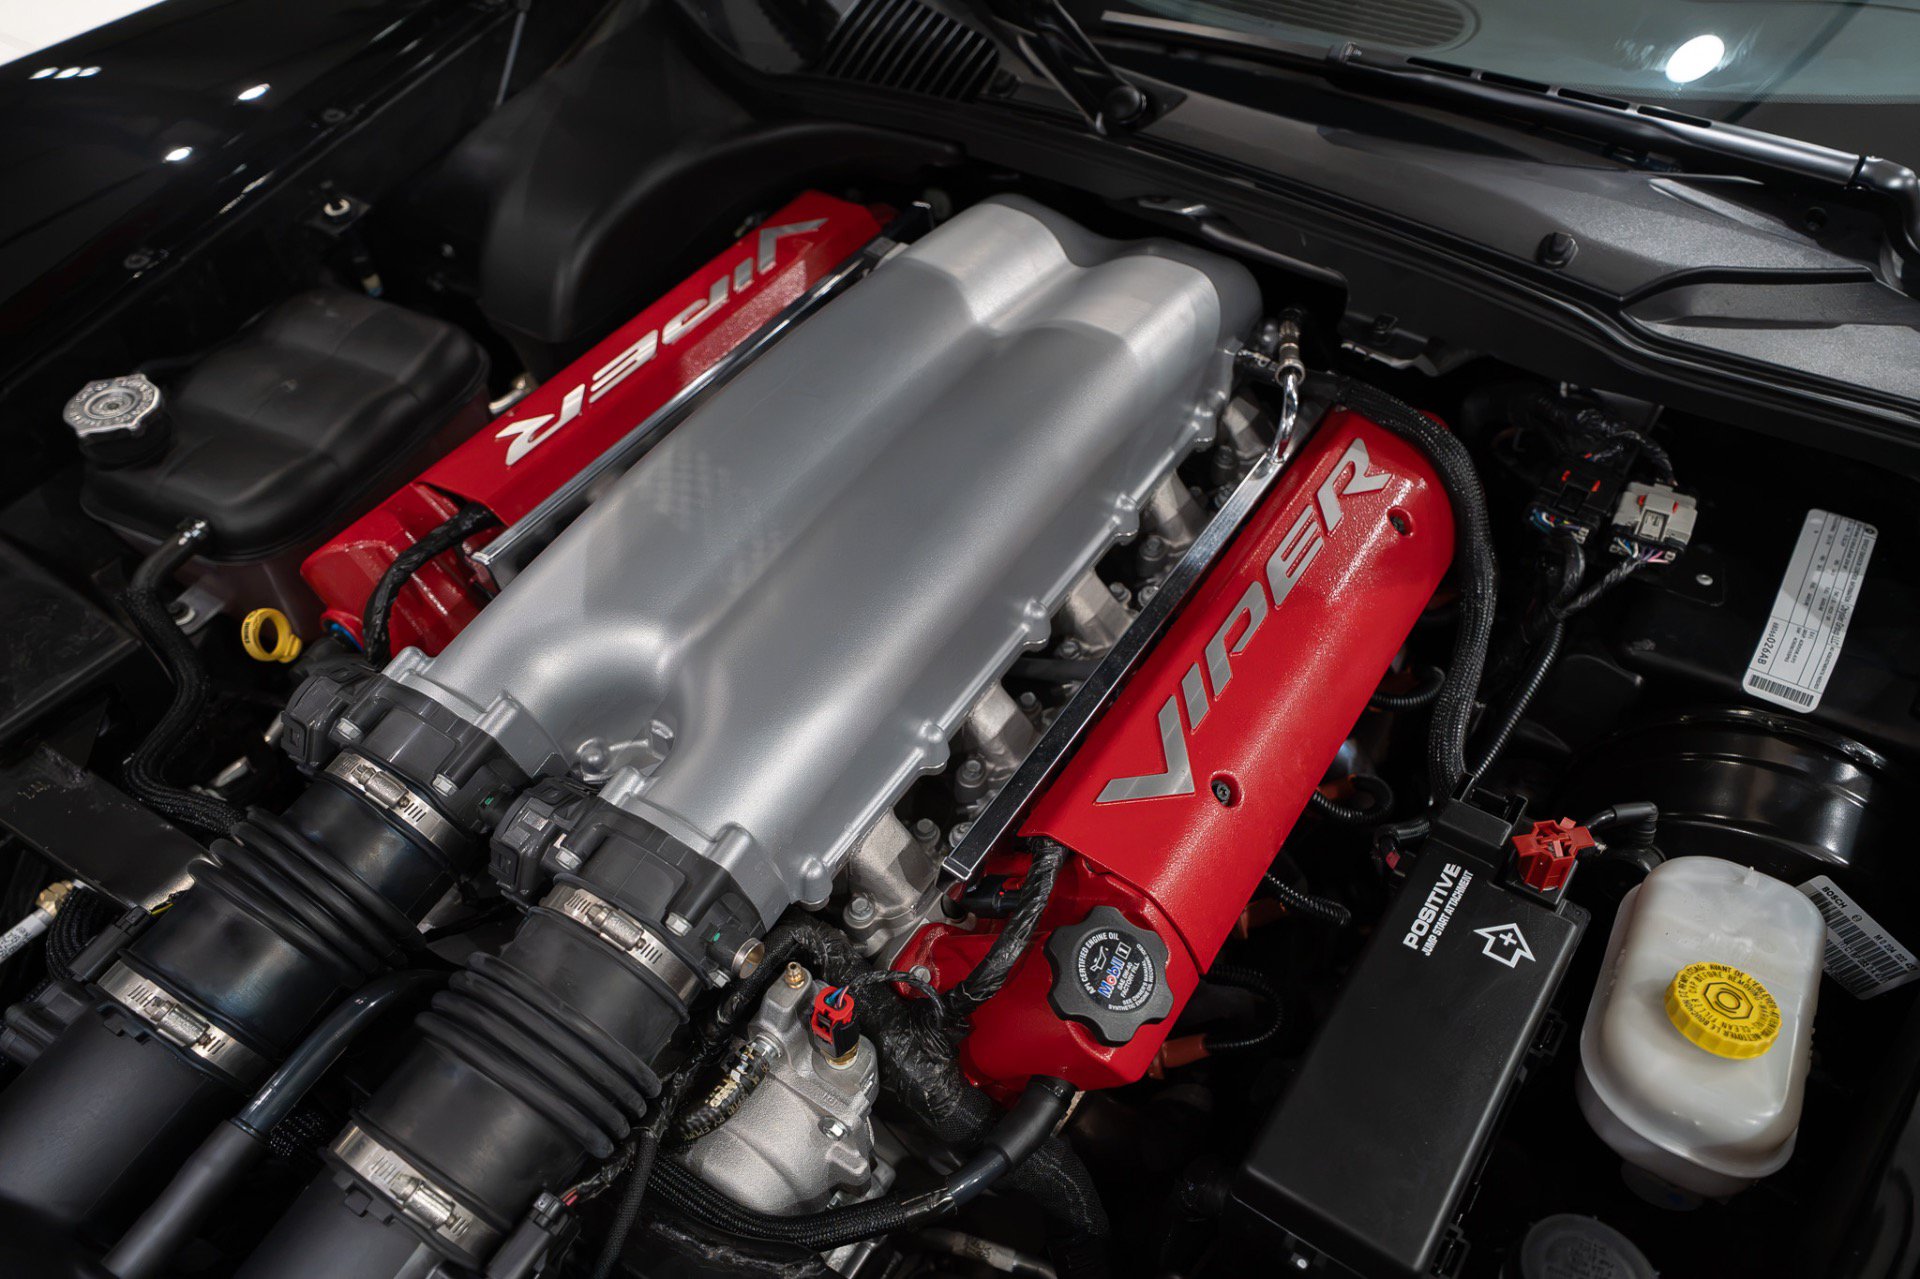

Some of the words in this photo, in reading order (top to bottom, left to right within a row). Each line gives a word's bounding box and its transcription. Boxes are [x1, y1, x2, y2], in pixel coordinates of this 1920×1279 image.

[495, 217, 828, 467] VIPER
[1095, 437, 1392, 804] VIPER
[1403, 863, 1462, 950] POSITIVE
[1421, 935, 1438, 957] JUMP
[1433, 915, 1451, 936] START
[1445, 869, 1474, 917] ATTACHMENT
[1821, 886, 1848, 909] BOSCH
[1085, 933, 1107, 947] ENGINE
[1108, 932, 1119, 940] OIL
[1078, 947, 1089, 982] CERTIFIED
[1097, 956, 1125, 999] Mobil
[1121, 974, 1134, 998] FACTORY
[1129, 962, 1139, 977] FILL
[1709, 964, 1732, 973] AVANT
[1084, 982, 1096, 994] API
[1117, 977, 1125, 990] SAE
